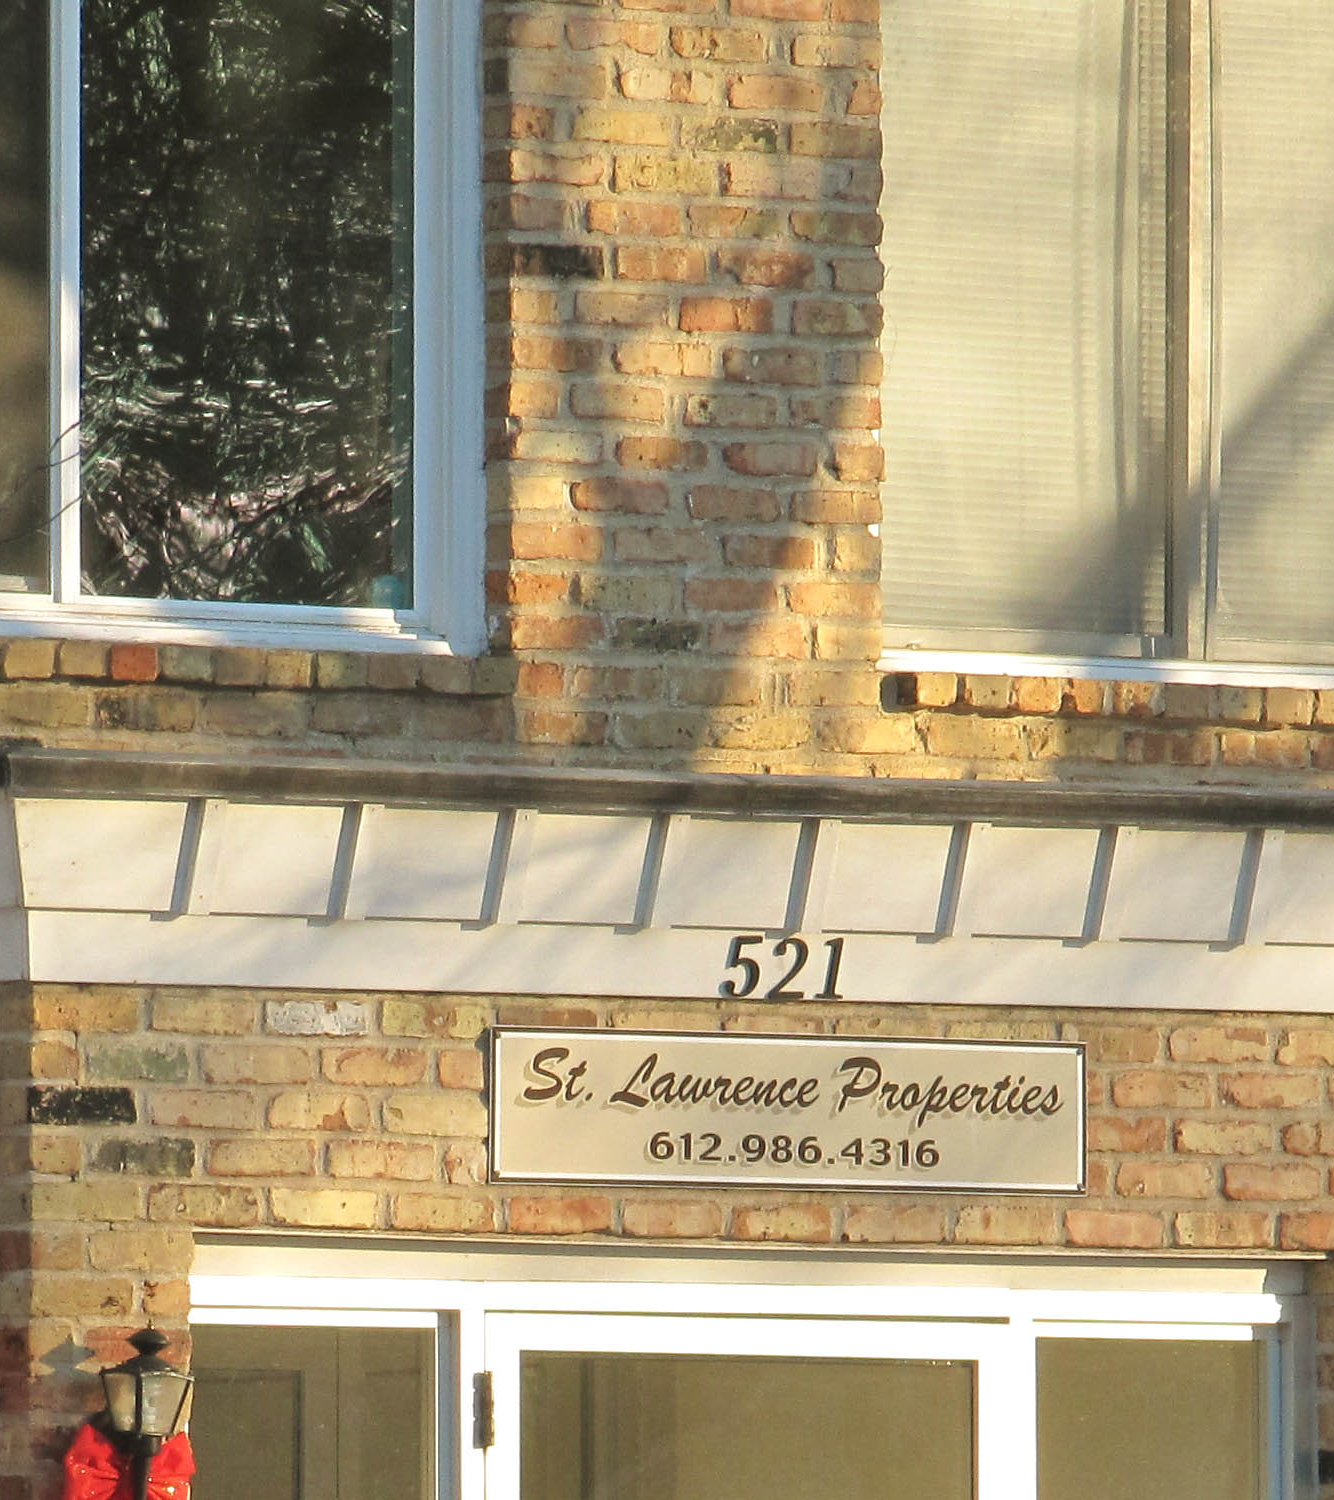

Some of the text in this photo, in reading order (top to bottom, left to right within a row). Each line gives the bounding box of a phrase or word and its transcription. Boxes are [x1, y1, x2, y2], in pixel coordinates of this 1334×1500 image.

[720, 934, 845, 1000] 521
[523, 1046, 1066, 1129] St. Lawrence Properties
[648, 1131, 941, 1169] 612.986.4316
